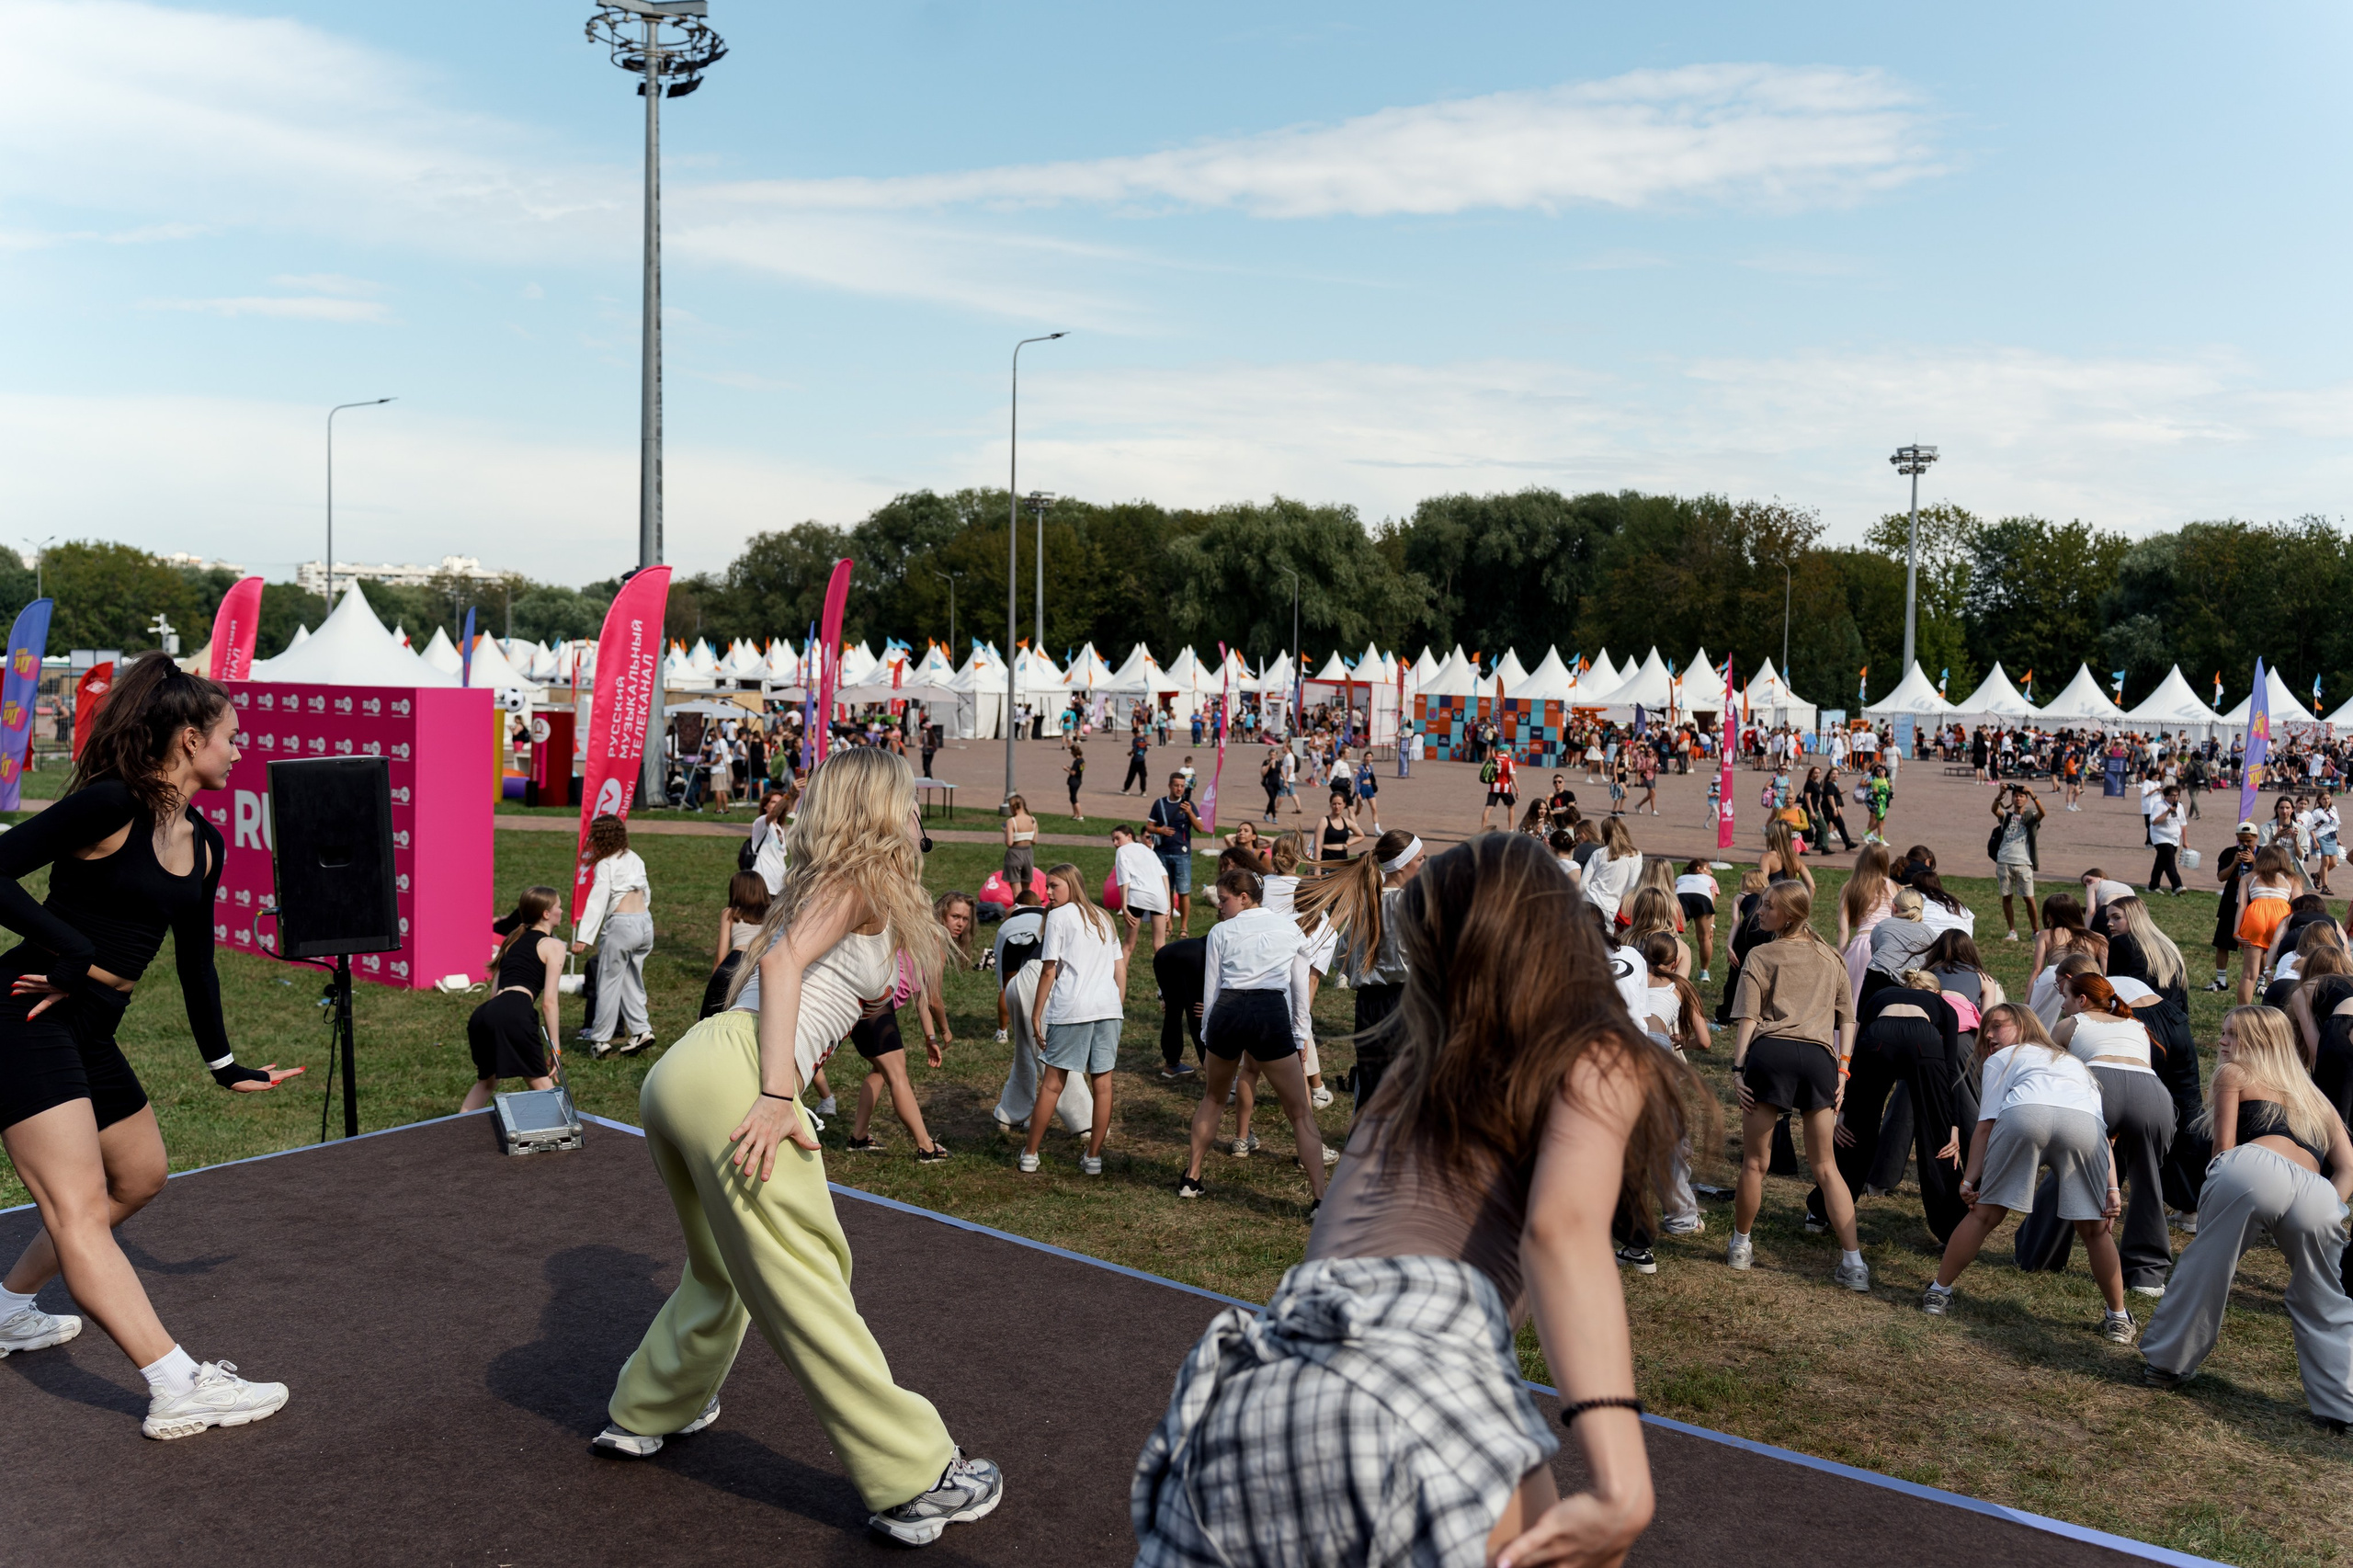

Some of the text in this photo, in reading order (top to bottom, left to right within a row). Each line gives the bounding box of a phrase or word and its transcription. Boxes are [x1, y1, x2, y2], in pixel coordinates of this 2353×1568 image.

[608, 676, 625, 757] РУССКИЙ
[619, 619, 643, 759] МУЗЫКАЛЬНЫЙ
[630, 653, 654, 759] ТЕЛЕКАНАЛ
[619, 780, 635, 817] ЗЫКУ!
